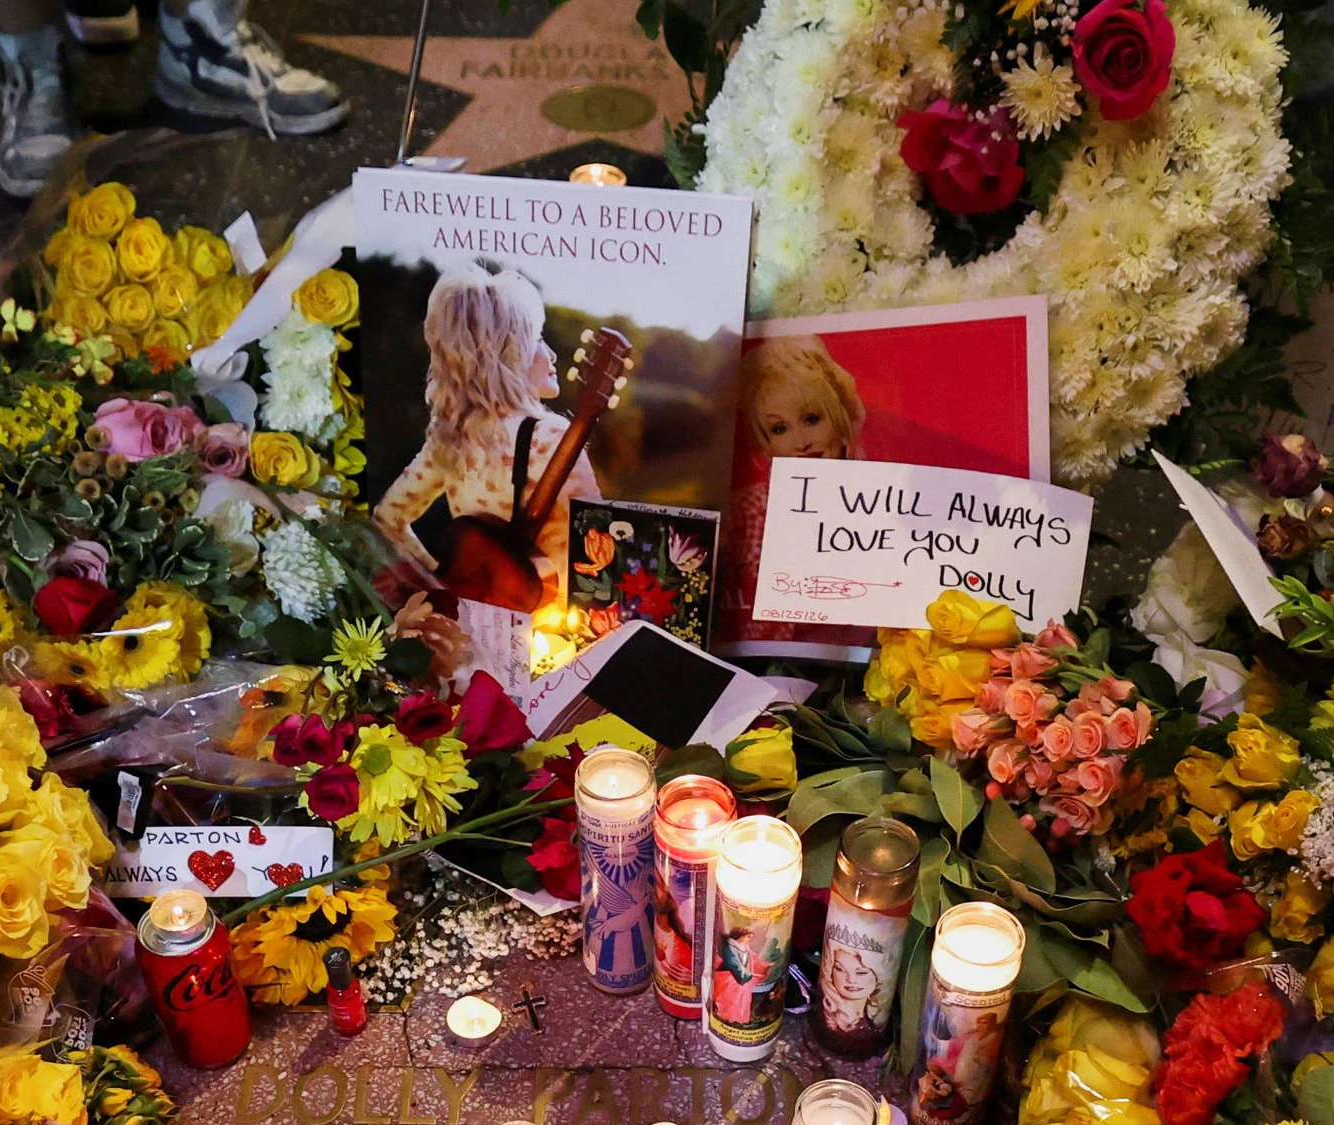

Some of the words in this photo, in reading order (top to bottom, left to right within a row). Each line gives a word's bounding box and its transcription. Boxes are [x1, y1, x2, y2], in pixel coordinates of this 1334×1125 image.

[510, 44, 666, 60] DOUGLA
[381, 188, 516, 221] FAREWELL
[525, 199, 562, 225] TO
[571, 203, 588, 227] A
[599, 205, 723, 237] BELOVED
[432, 227, 578, 259] AMERICAN
[590, 238, 667, 266] ICON.
[790, 476, 818, 514] I
[839, 485, 933, 517] WILL
[947, 492, 1072, 550] ALWAYS
[816, 522, 897, 553] LOVE
[939, 564, 1035, 622] DOLLY
[146, 830, 242, 845] PARTON
[628, 822, 654, 841] SANT
[104, 865, 178, 883] ALWAYS
[251, 854, 329, 882] YU!
